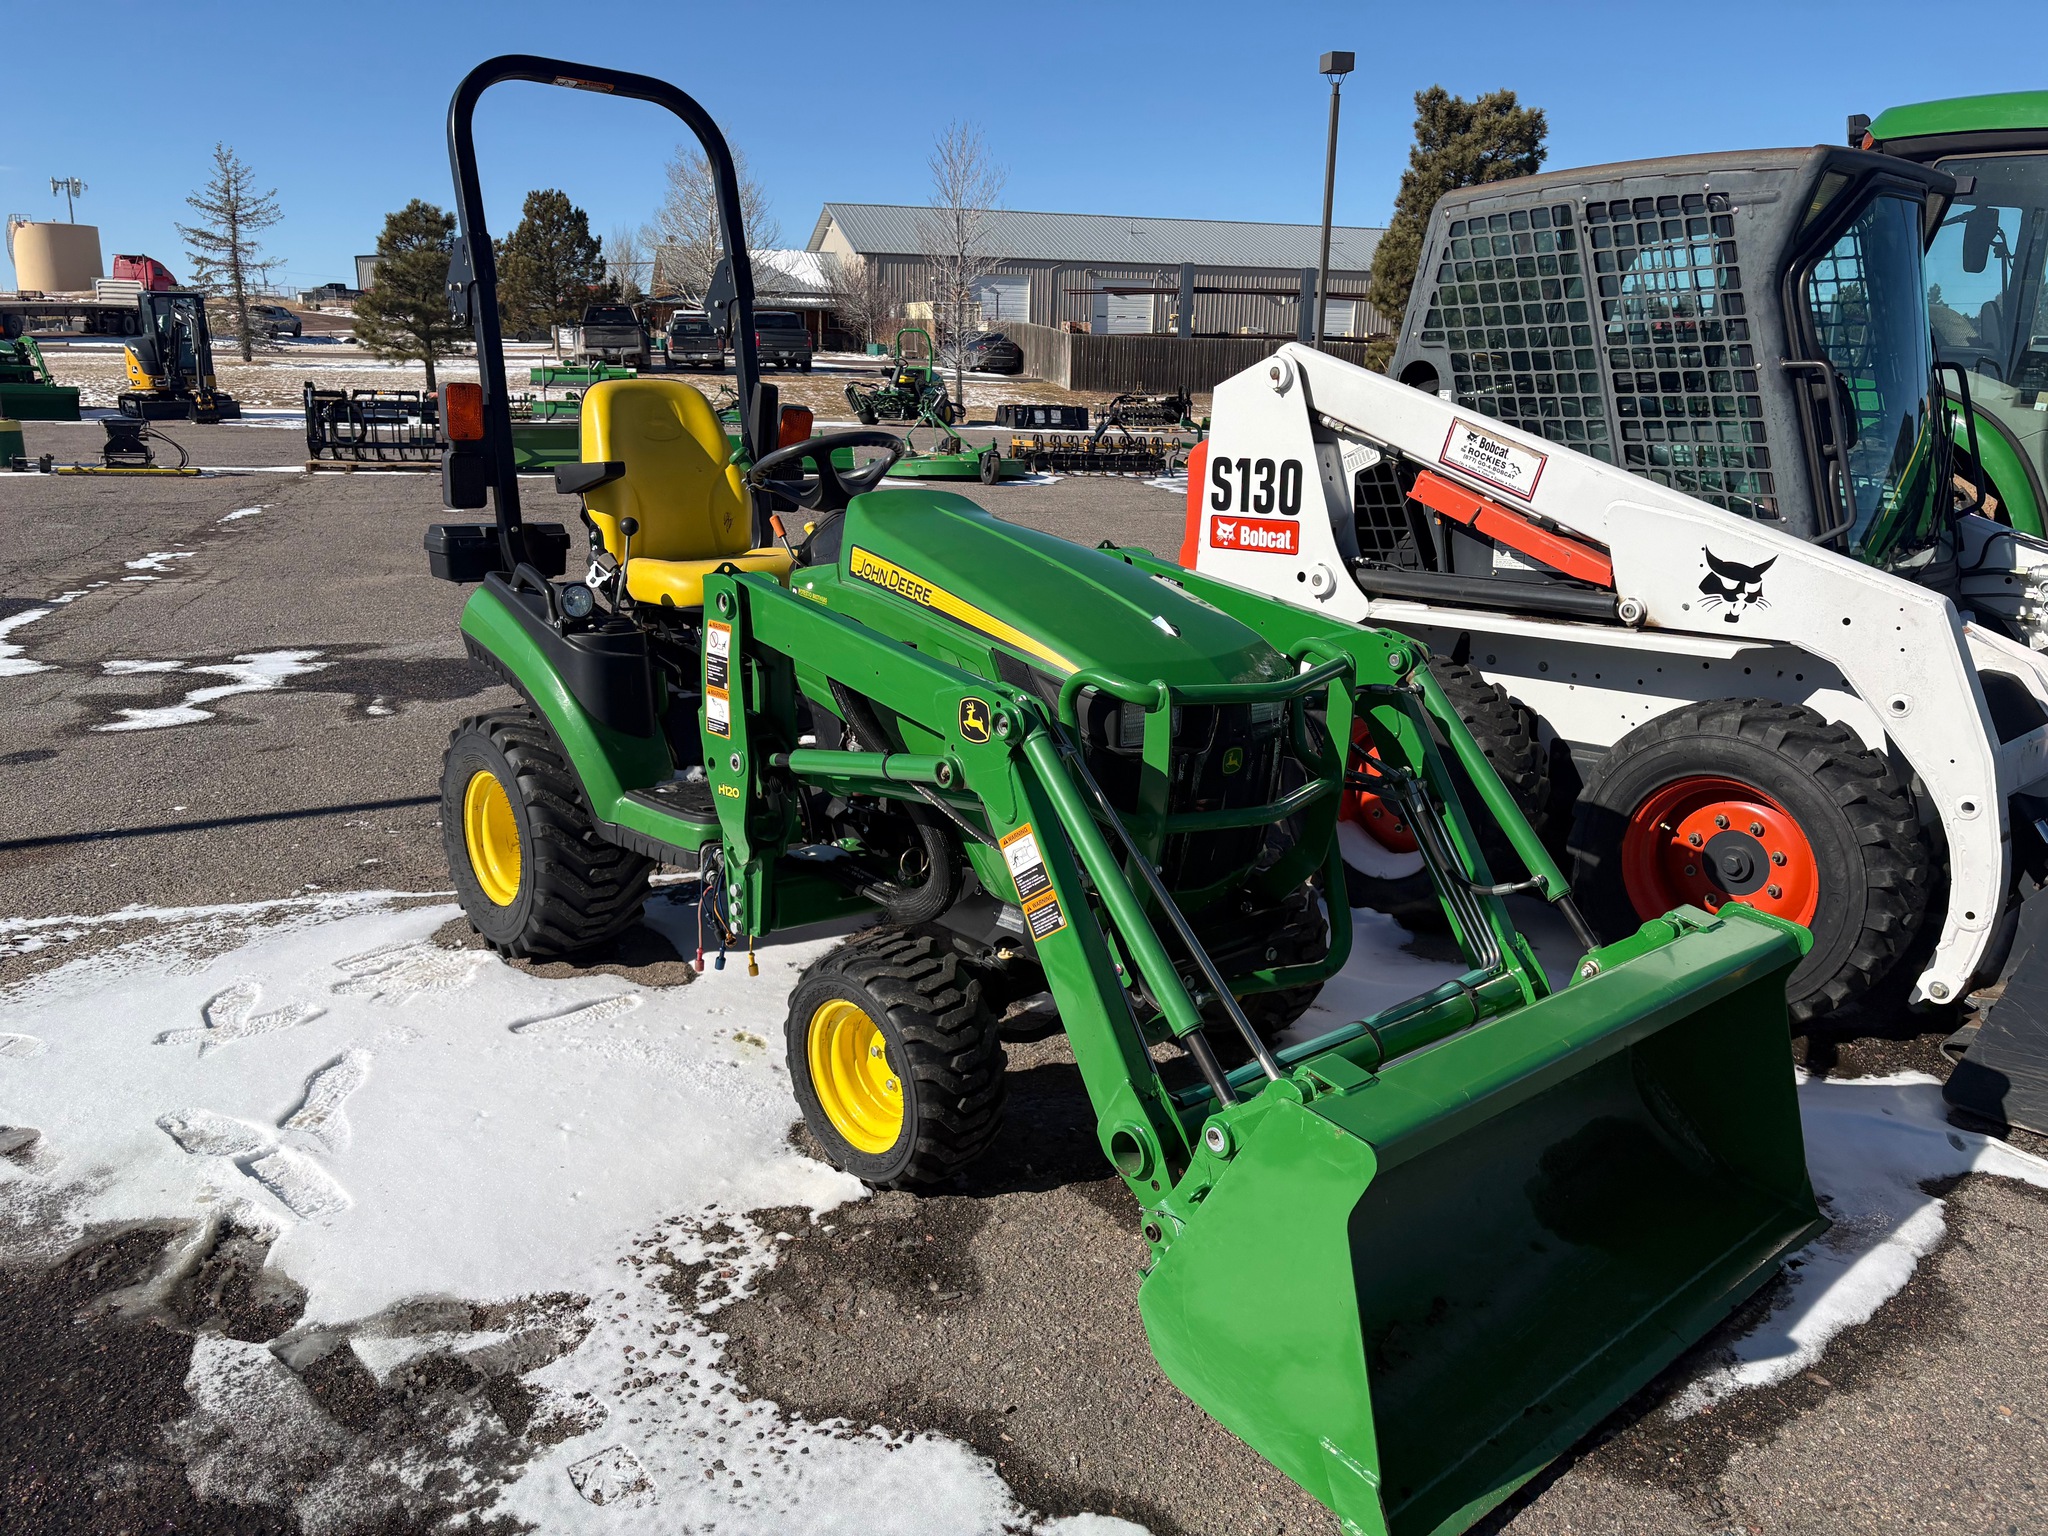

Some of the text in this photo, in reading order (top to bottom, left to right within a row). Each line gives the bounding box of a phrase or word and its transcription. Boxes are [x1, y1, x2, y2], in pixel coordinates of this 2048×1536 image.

[1467, 447, 1507, 469] ROCKIES
[1479, 437, 1509, 459] Bobcat
[1211, 456, 1303, 516] S130
[1240, 525, 1292, 550] Bobcat
[857, 558, 932, 604] JOHN DEERE
[718, 783, 740, 799] H120
[1007, 826, 1029, 842] WARNING
[1031, 894, 1054, 909] WARNING
